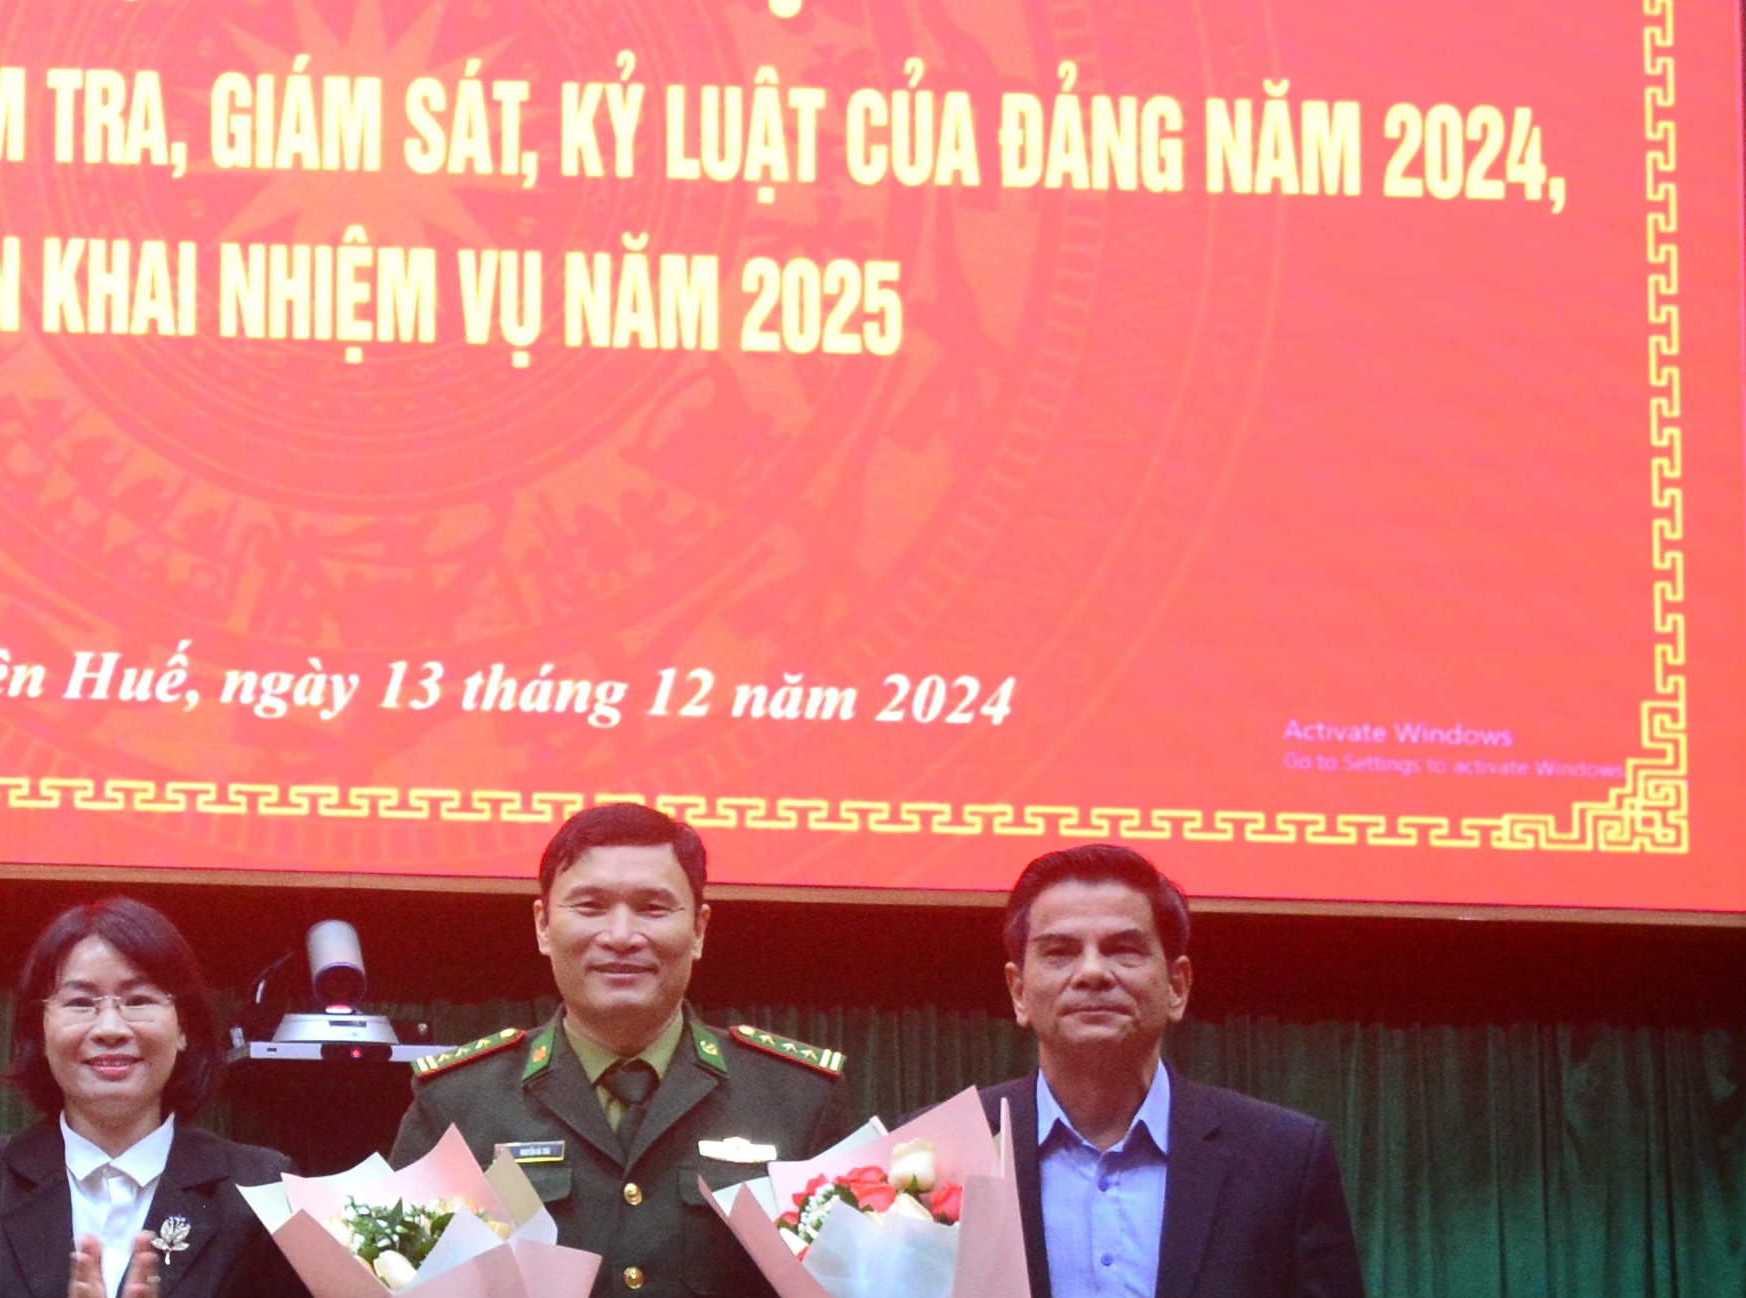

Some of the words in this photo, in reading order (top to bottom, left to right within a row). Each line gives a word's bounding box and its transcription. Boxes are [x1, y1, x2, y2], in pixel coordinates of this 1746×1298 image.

[47, 68, 187, 178] TRA,
[211, 54, 382, 171] GIÁM
[404, 58, 537, 188] SÁT,
[562, 50, 644, 178] KỶ
[667, 66, 826, 203] LUẬT
[847, 58, 980, 186] CỦA
[999, 61, 1182, 192] ĐẢNG
[1206, 80, 1360, 195] NĂM
[1384, 104, 1565, 213] 2024,
[43, 237, 196, 336] KHAI
[220, 225, 436, 363] NHIỆM
[458, 249, 542, 367] VỤ
[565, 233, 719, 350] NĂM
[741, 257, 902, 355] 2025
[62, 639, 200, 712] Huế,
[219, 657, 360, 721] ngày
[380, 660, 444, 710] 13
[461, 662, 629, 728] tháng
[647, 667, 715, 717] 12
[731, 673, 857, 721] năm
[875, 673, 1016, 725] 2024
[1282, 719, 1386, 744] Activate
[1394, 721, 1513, 747] Windows
[1282, 751, 1313, 770] Go
[1317, 753, 1338, 771] to
[1343, 753, 1420, 777] Settings
[1426, 756, 1448, 774] to
[1453, 757, 1529, 777] activate
